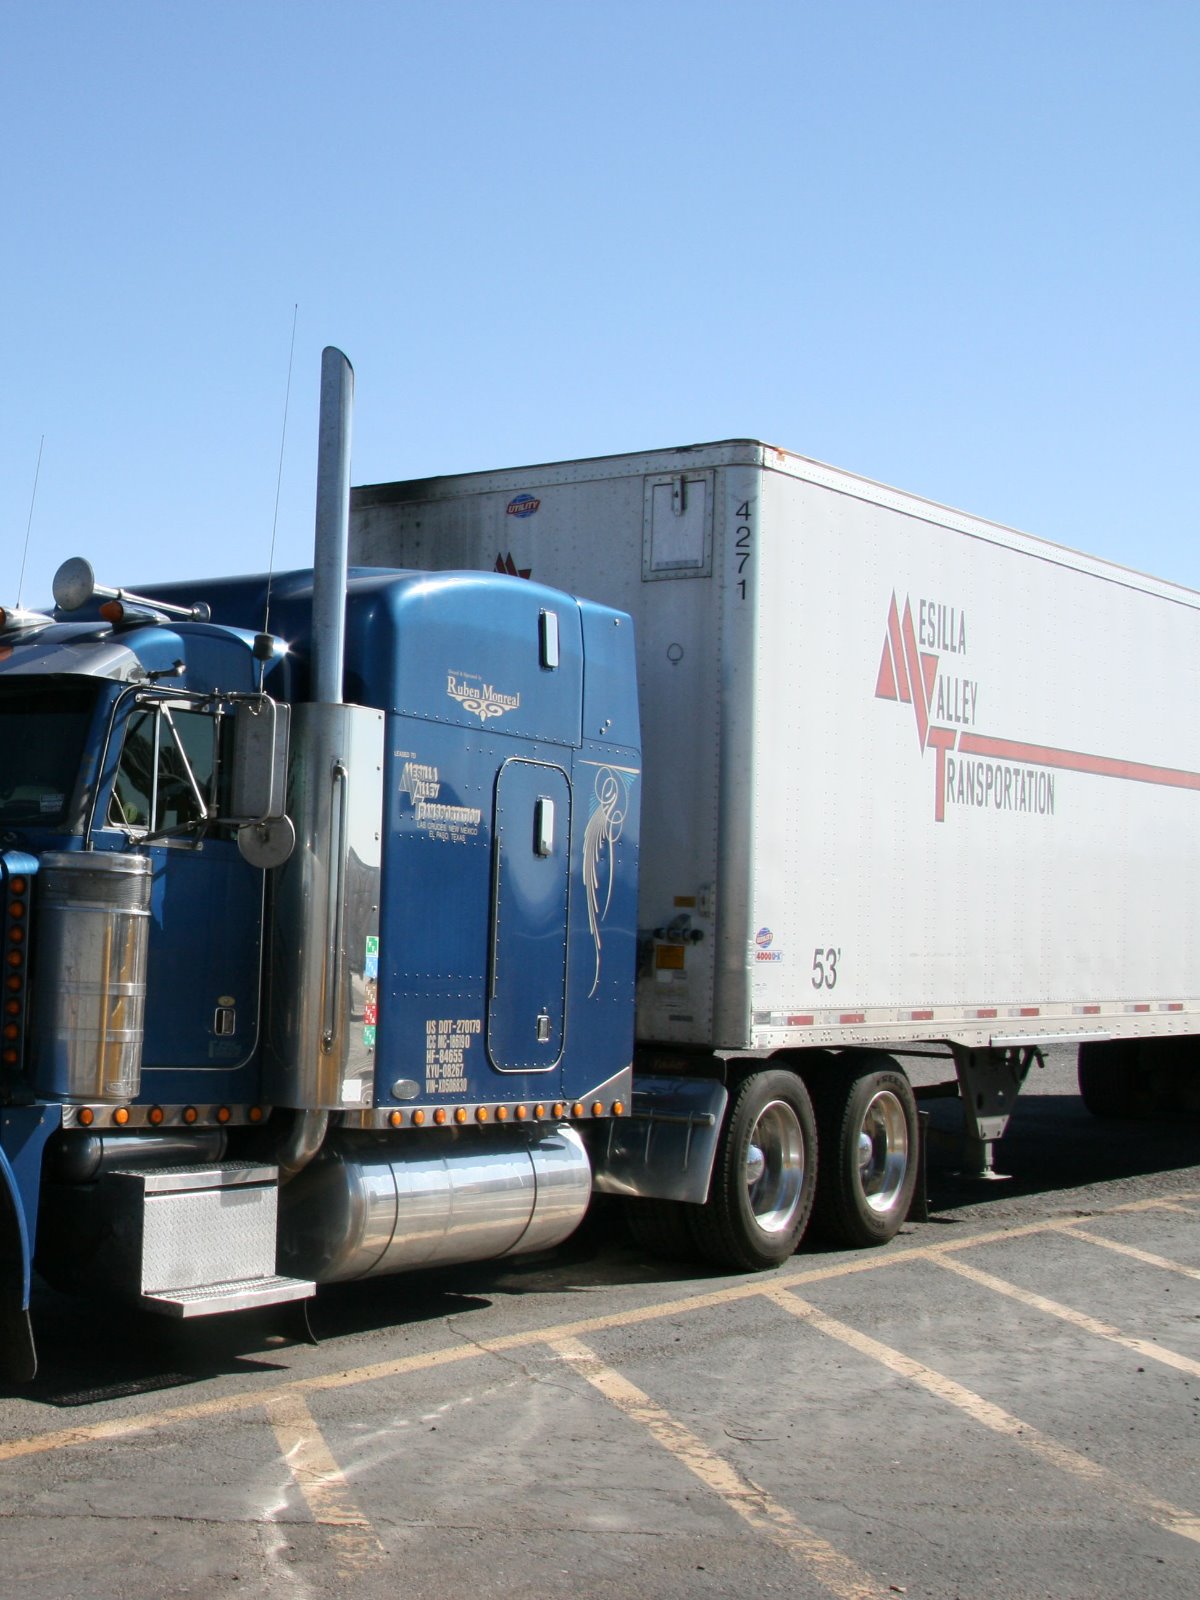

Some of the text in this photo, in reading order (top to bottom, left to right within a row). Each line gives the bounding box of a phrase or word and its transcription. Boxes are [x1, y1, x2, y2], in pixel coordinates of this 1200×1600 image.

[508, 501, 538, 513] UTILITY
[735, 500, 752, 600] 4271
[447, 675, 520, 707] Ruben Monreal
[426, 1020, 437, 1034] US
